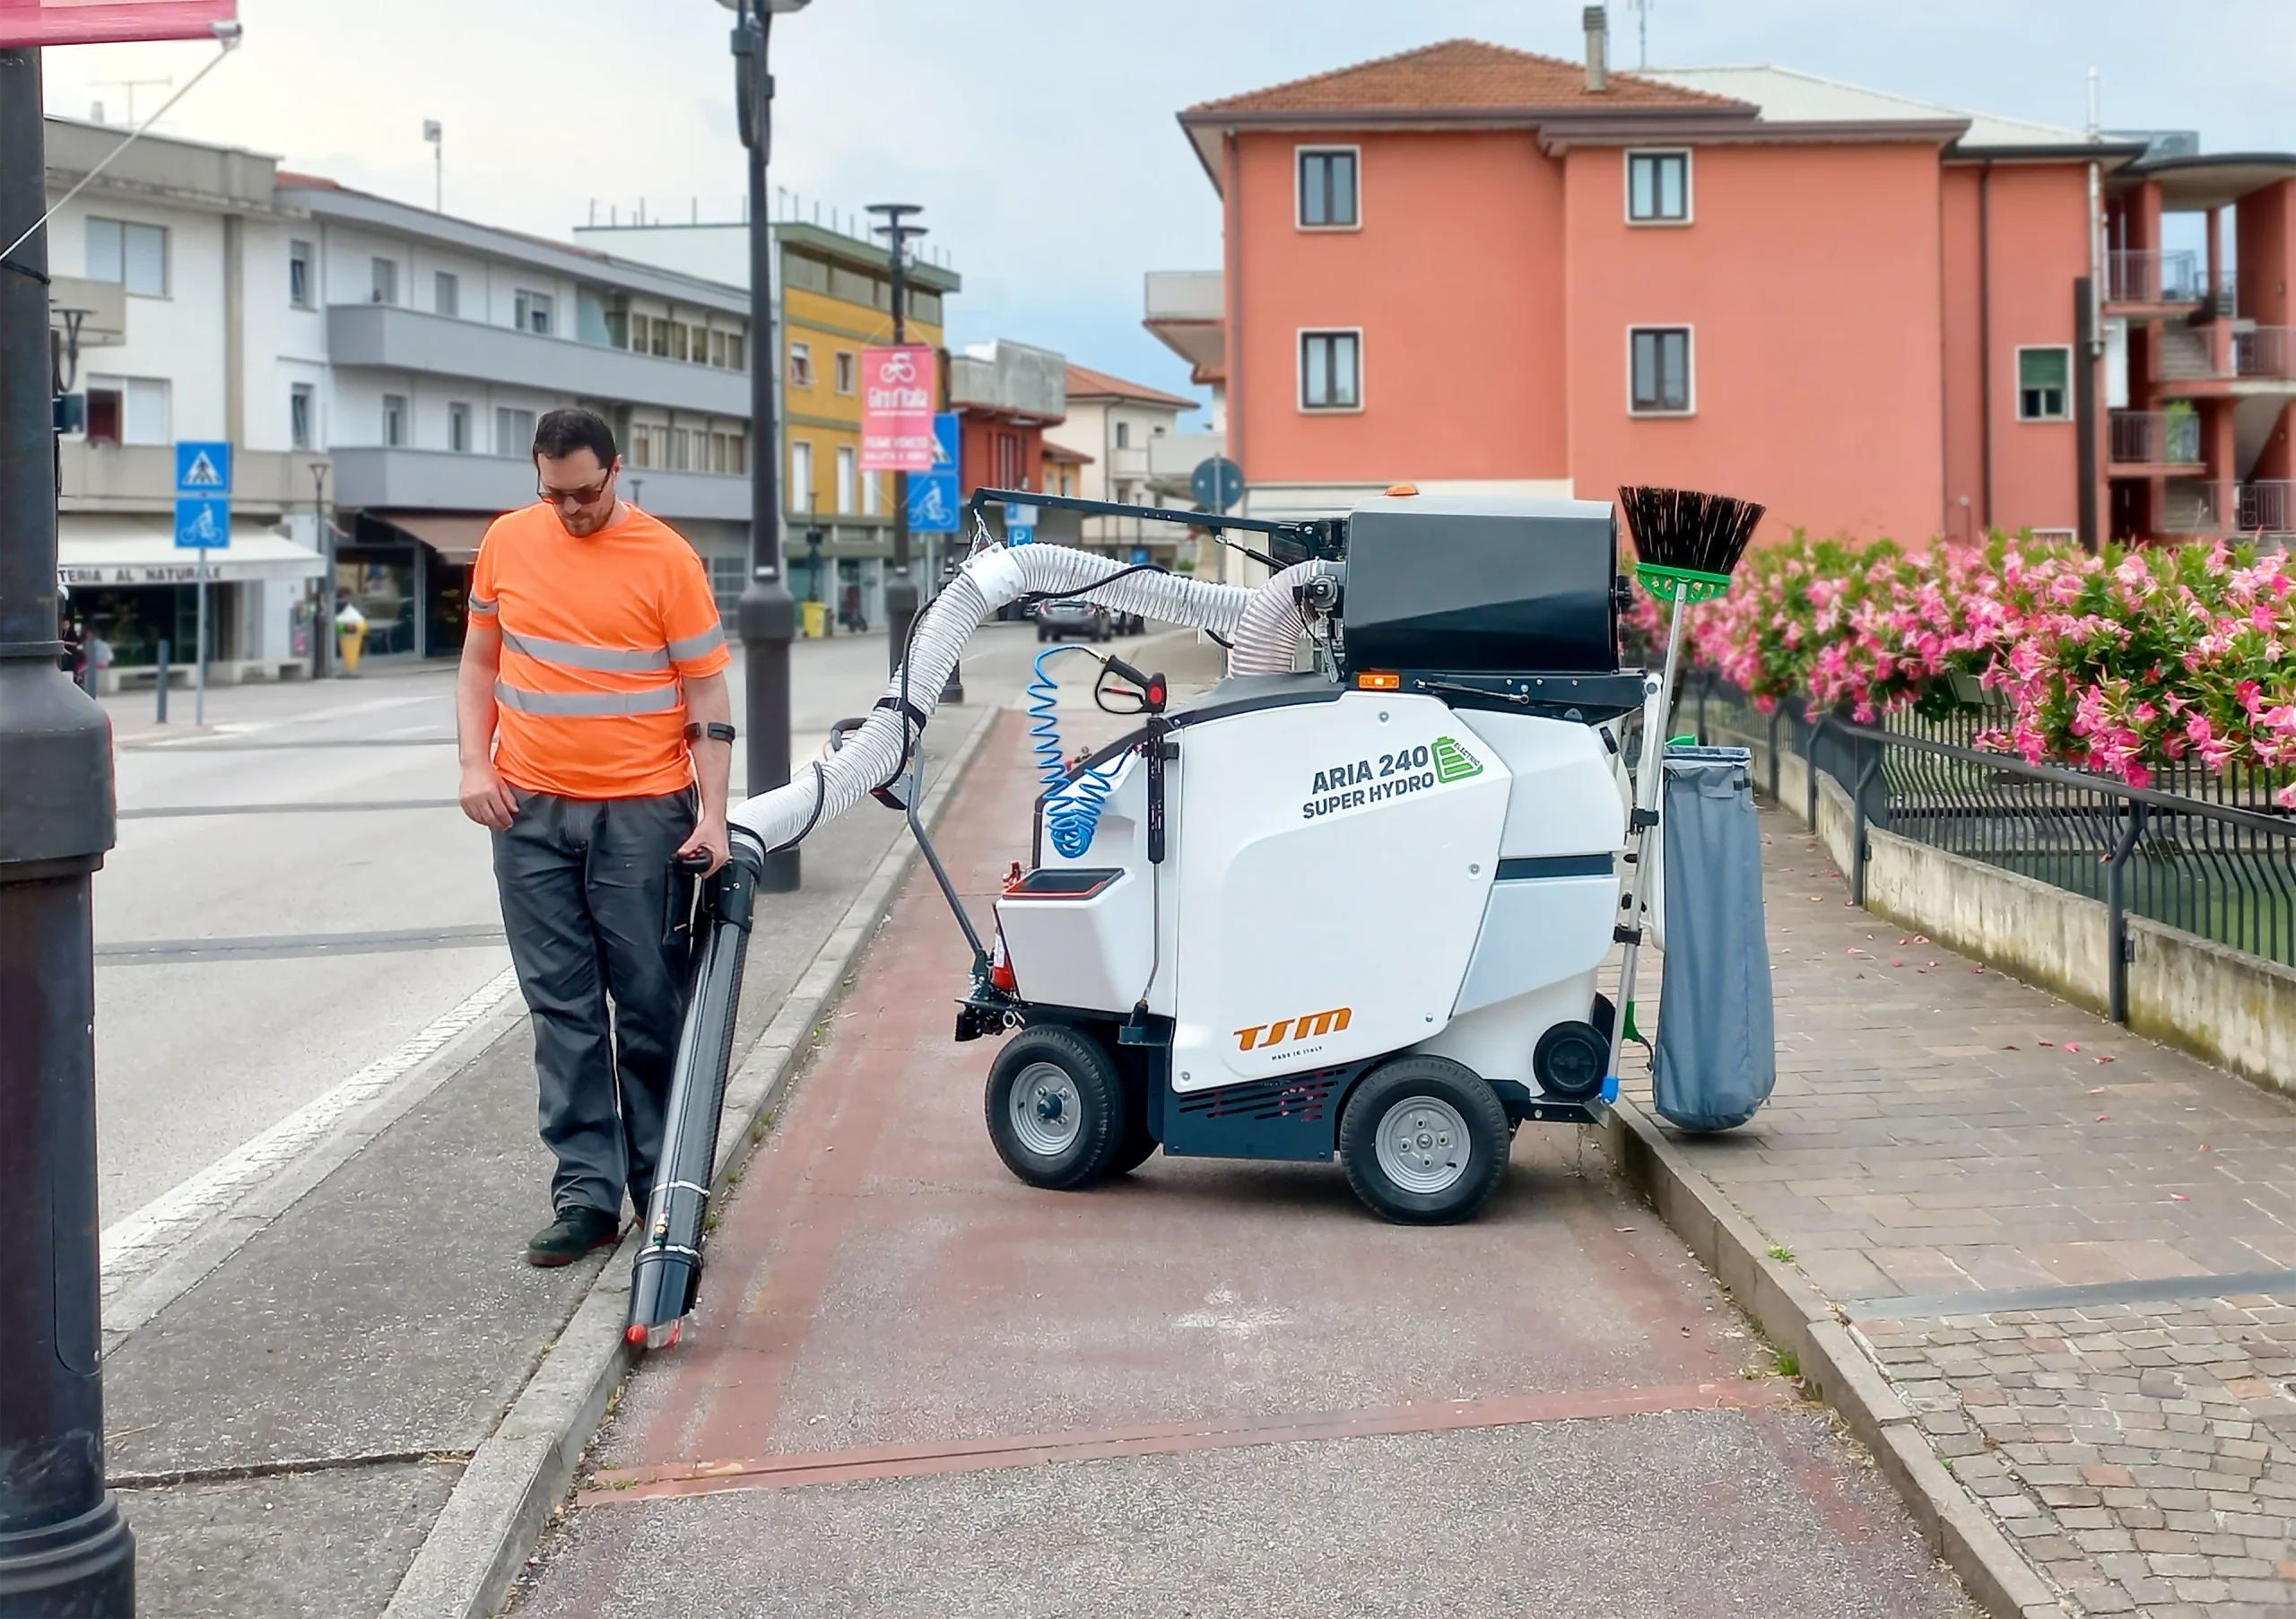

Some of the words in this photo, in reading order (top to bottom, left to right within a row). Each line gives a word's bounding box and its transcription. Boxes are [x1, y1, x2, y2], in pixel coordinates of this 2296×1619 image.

[1013, 529, 1026, 545] P
[116, 570, 134, 581] AL
[145, 567, 222, 580] NATURLE
[1453, 742, 1481, 767] ELECTRIC
[1312, 760, 1373, 795] ARIA
[1378, 745, 1429, 777] 240
[1302, 789, 1366, 828] SUPER
[1370, 772, 1434, 802] HYDRO
[1233, 1007, 1352, 1051] TSM
[1272, 1052, 1292, 1061] MADE
